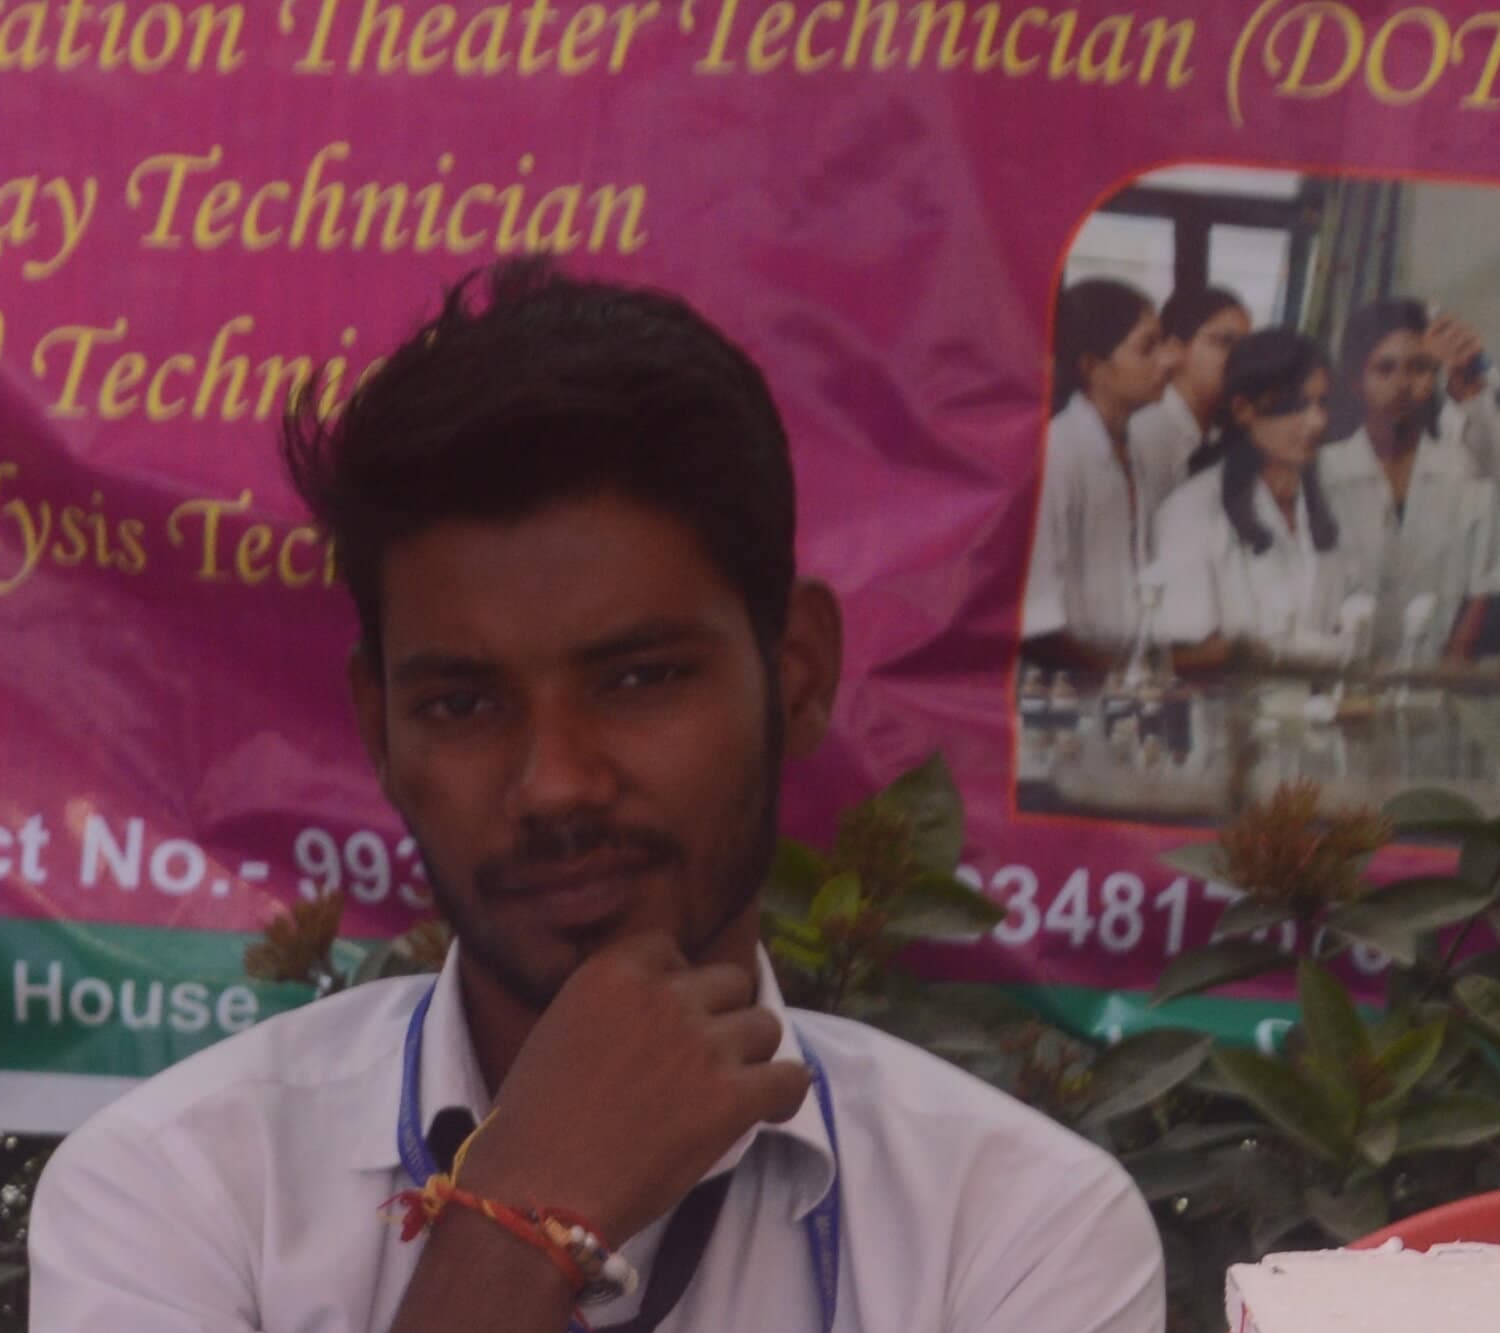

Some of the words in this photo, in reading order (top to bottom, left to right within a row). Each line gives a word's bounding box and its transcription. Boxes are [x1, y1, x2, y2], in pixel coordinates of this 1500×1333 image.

[277, 0, 655, 77] Theater
[678, 0, 1193, 89] Technician
[125, 141, 649, 254] Technician
[13, 961, 260, 1033] House
